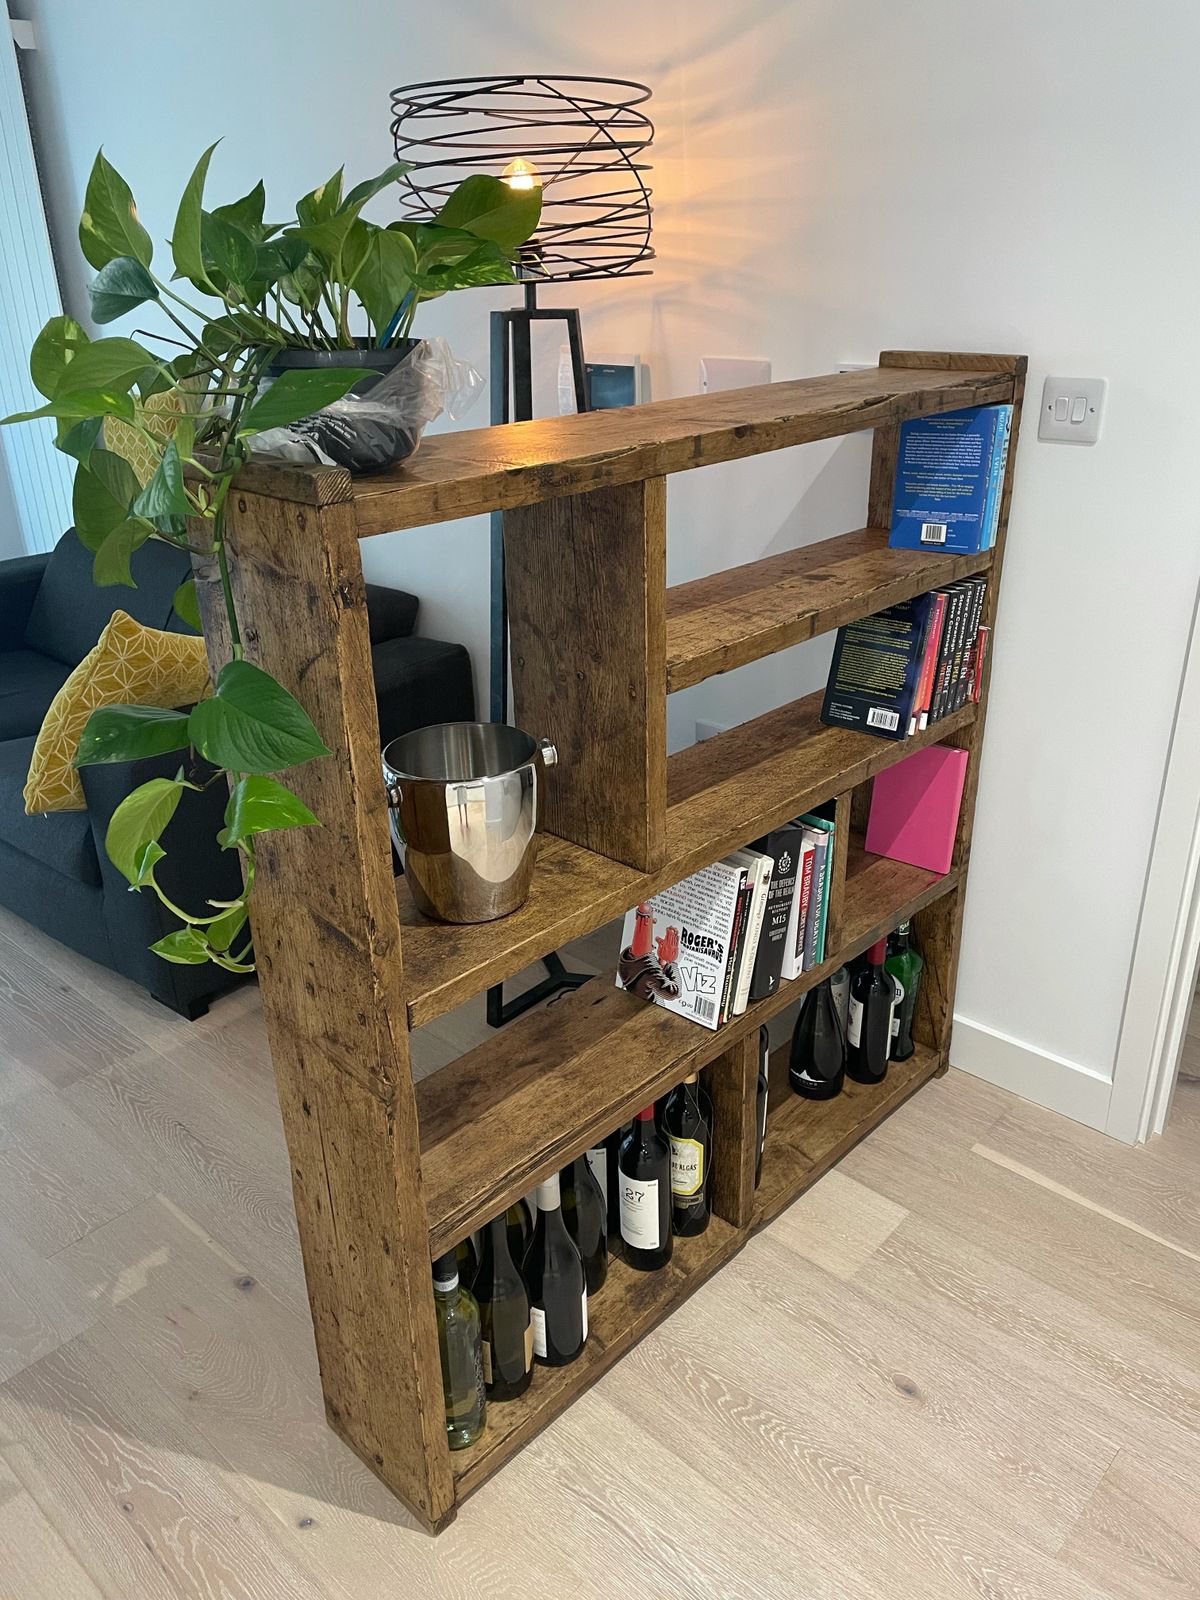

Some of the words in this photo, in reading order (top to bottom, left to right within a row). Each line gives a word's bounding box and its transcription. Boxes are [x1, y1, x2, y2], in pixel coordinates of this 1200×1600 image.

[964, 590, 973, 611] Steve
[979, 583, 987, 604] Steve
[950, 597, 958, 619] Steve
[956, 594, 965, 616] Steve
[958, 612, 968, 648] Cavanagh
[972, 605, 983, 640] Cavanagh
[943, 620, 954, 657] Cavanagh
[950, 616, 961, 653] Cavanagh
[954, 651, 962, 664] THE
[951, 665, 960, 685] PLEA
[804, 855, 814, 877] TOM
[770, 881, 779, 890] THE
[801, 874, 811, 907] BRADBY
[771, 913, 787, 926] MI5
[680, 926, 724, 954] ROGER'S
[679, 1163, 697, 1172] ALGAS
[625, 1187, 645, 1202] 27
